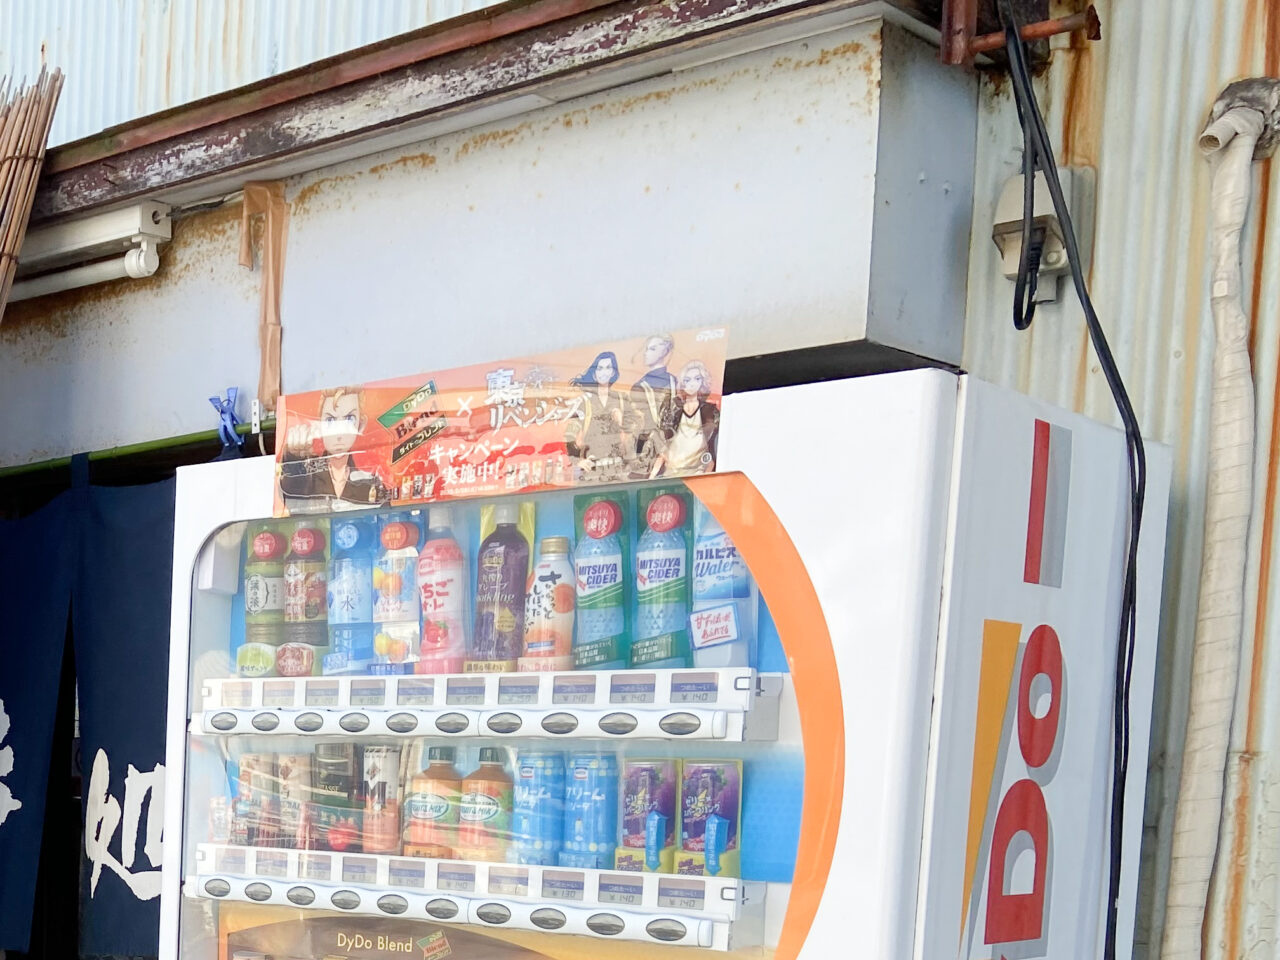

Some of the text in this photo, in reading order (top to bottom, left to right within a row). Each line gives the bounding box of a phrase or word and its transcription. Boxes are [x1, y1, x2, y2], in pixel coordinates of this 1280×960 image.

[484, 371, 525, 406] 東京
[429, 437, 519, 465] キャンペーン
[578, 563, 617, 577] MITSUYA
[639, 557, 680, 572] MITSUYA
[586, 573, 617, 585] CIDER
[647, 568, 680, 580] CIDER
[336, 932, 413, 953] DyDo Blend
